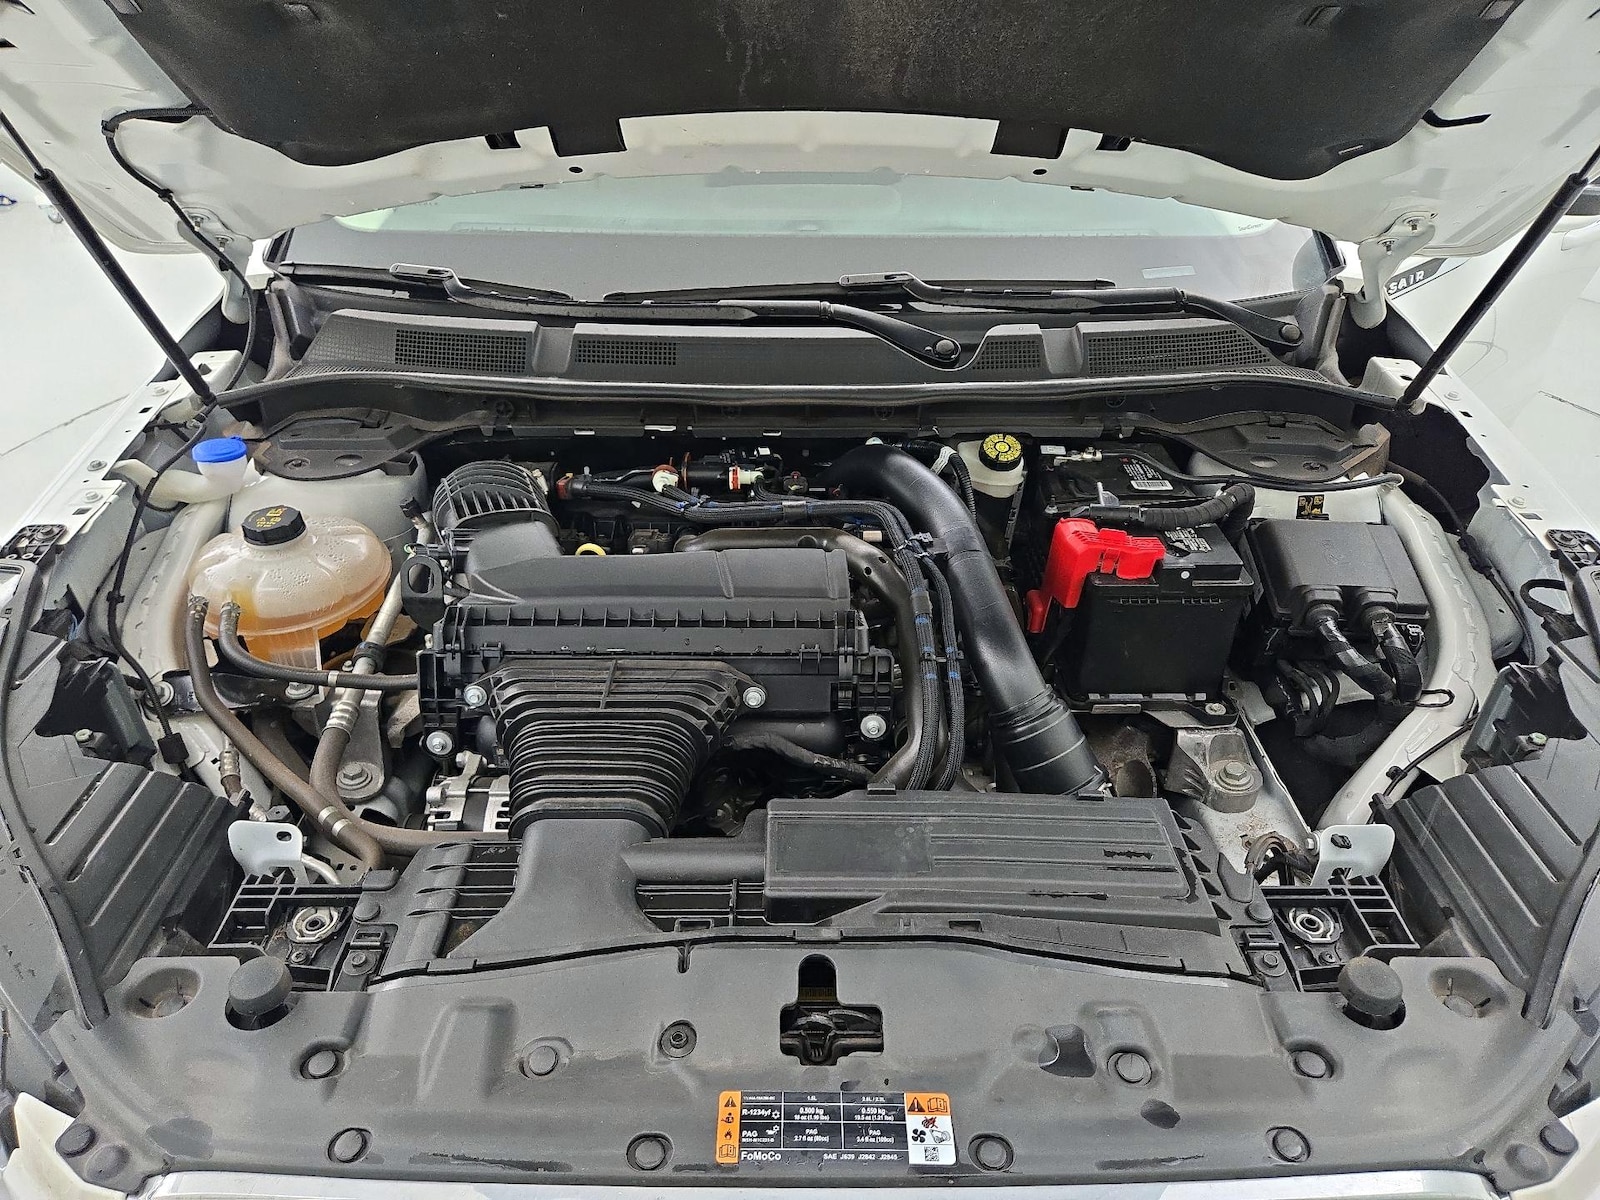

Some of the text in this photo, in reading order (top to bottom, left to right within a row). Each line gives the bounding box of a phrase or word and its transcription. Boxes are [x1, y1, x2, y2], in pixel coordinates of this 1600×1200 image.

[1387, 270, 1425, 294] SAIR
[742, 1108, 771, 1117] R-1234yf
[816, 1107, 824, 1115] kg
[878, 1107, 886, 1115] kg
[742, 1130, 758, 1138] PAG
[741, 1151, 782, 1161] FoMoCo
